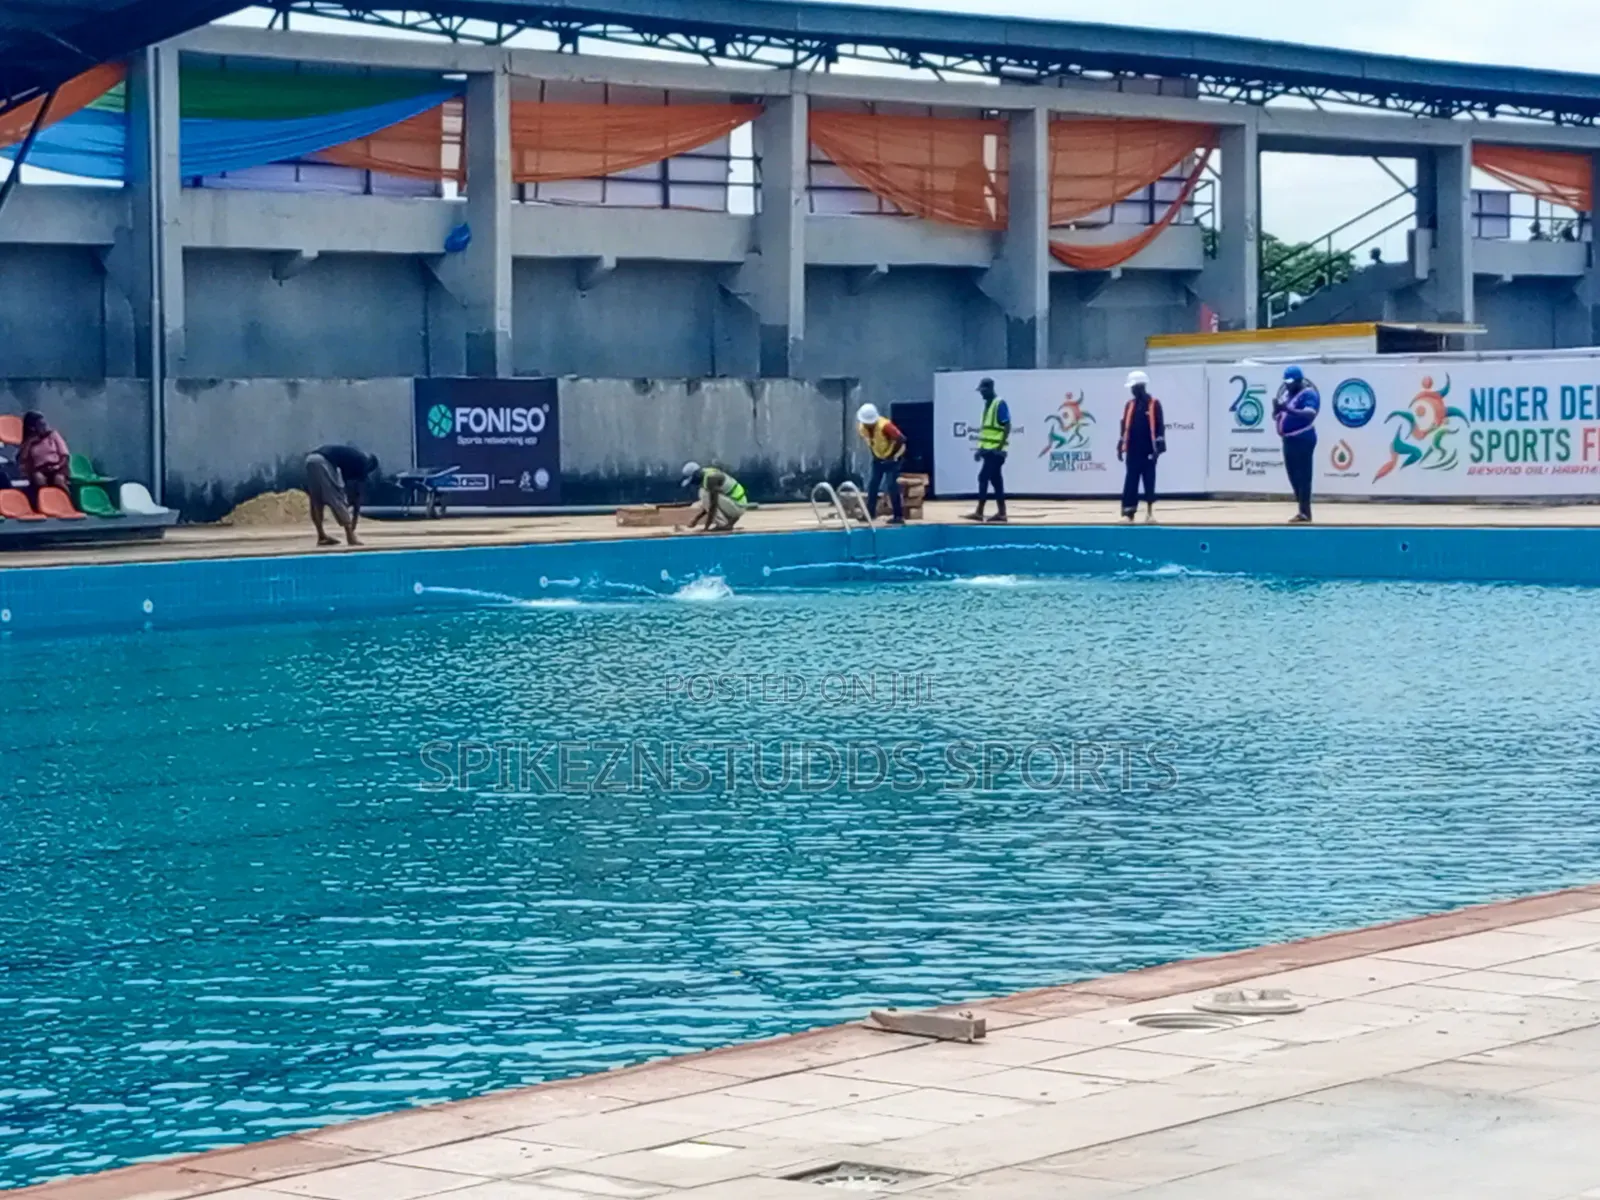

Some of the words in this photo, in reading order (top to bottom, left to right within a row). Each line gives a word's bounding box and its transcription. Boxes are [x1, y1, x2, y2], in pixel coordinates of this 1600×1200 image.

[1470, 386, 1549, 422] NIGER
[455, 407, 546, 433] FONISO
[457, 435, 482, 446] Sports
[1469, 428, 1571, 463] SPORTS
[1583, 427, 1600, 461] F
[1467, 466, 1522, 476] BEYOND
